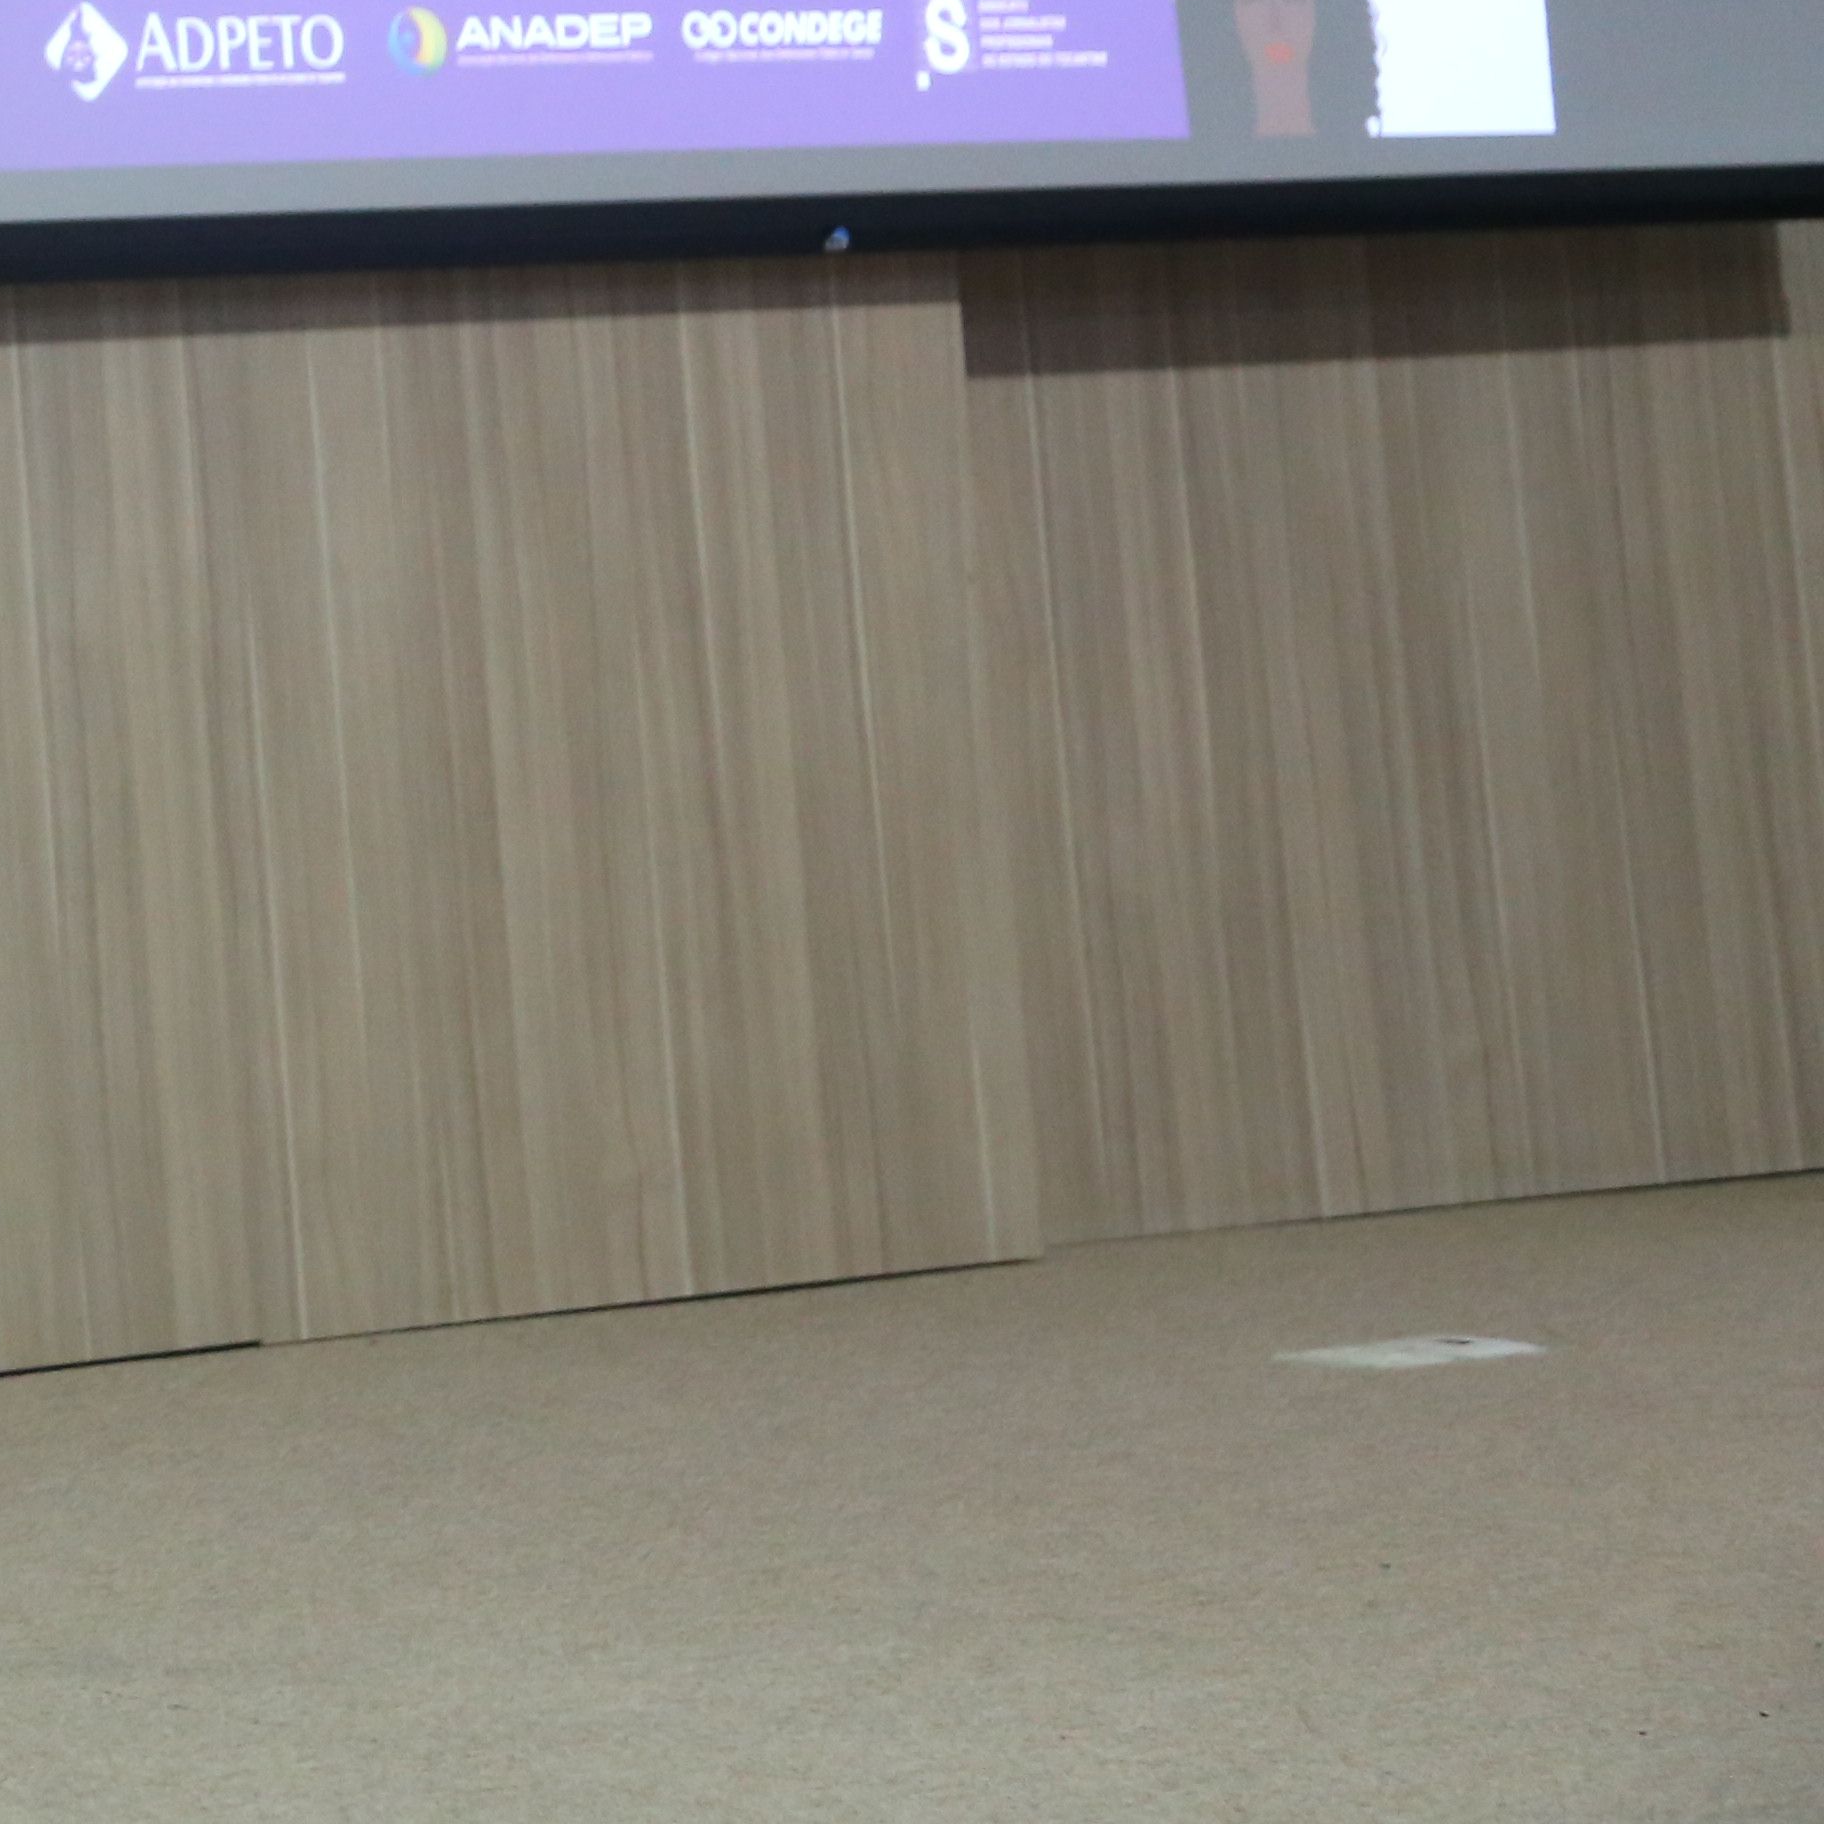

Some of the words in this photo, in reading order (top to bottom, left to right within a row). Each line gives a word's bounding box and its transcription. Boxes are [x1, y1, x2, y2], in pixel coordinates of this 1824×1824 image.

[135, 12, 343, 72] ADPETO
[457, 12, 652, 50] ANADEP
[740, 9, 883, 47] CONDEGE
